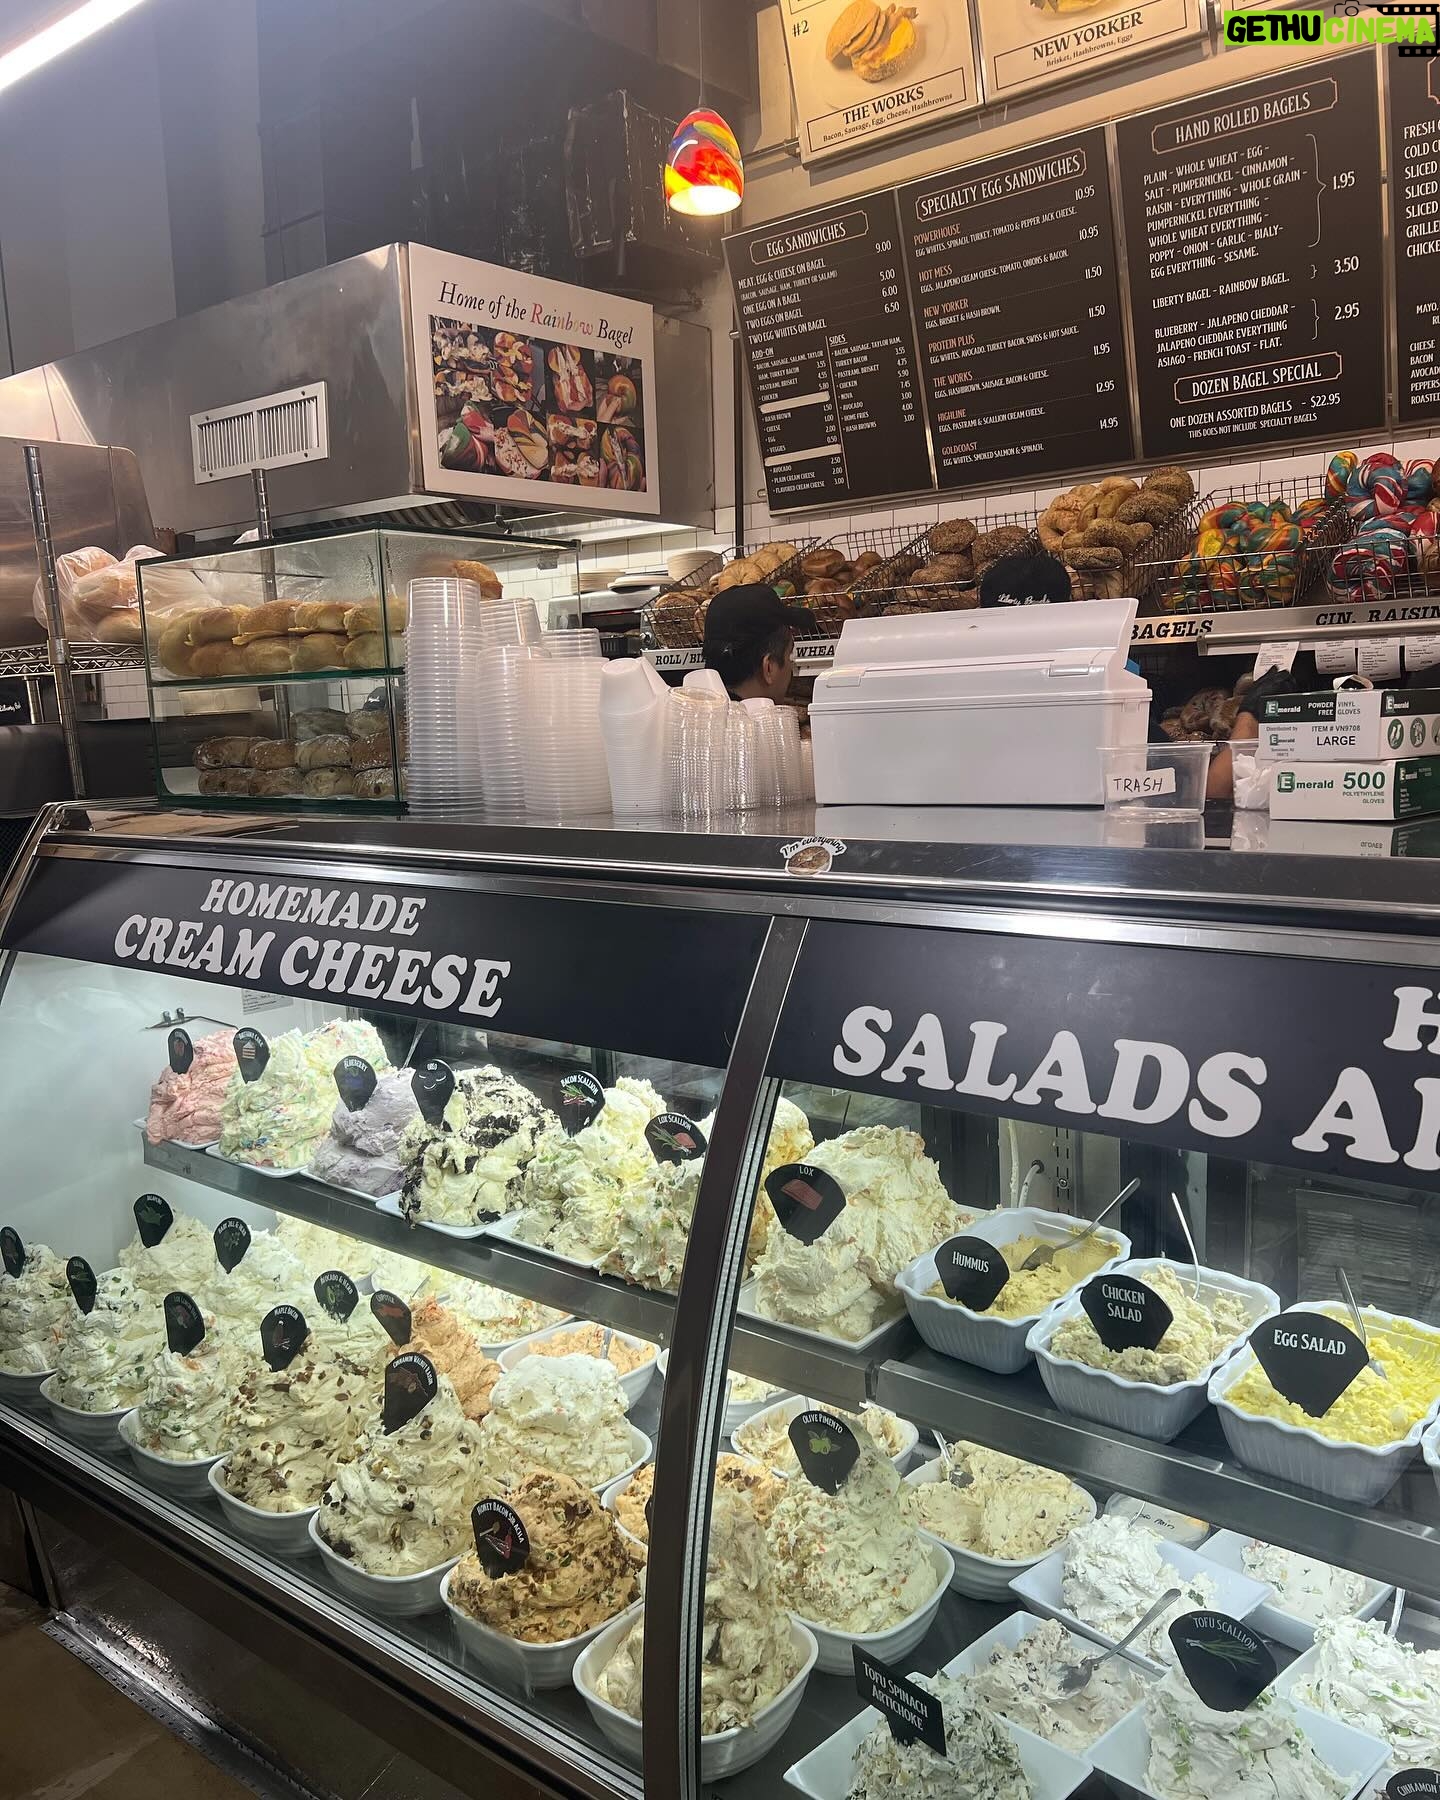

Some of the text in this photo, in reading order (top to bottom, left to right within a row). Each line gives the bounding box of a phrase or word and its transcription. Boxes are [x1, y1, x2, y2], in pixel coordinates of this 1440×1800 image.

[792, 20, 809, 38] #2
[1033, 11, 1143, 61] NEW YORKER
[842, 86, 924, 124] THE WORKS
[823, 93, 953, 142] Bacon, Sausage, Egg, Cheese, Hashbrowns
[1175, 92, 1311, 144] HAND ROLLED BAGELS
[1404, 119, 1436, 140] FRESH
[1404, 142, 1430, 159] COLD
[1143, 145, 1263, 186] PLAIN WHOLE WHEAT EGG
[1405, 160, 1438, 180] SLICED
[921, 154, 1081, 217] SPECIALTY EGG SANDWICHES
[1144, 155, 1289, 202] SALT PUMPERNICKEL CINNAMON
[1332, 171, 1356, 191] 1.95
[1075, 185, 1095, 201] 10.95
[1146, 169, 1301, 217] RAISIN EVERYTHING WHOLE GRAIN
[1405, 180, 1438, 200] SLICED
[1147, 196, 1260, 233] PUMPERNICKEL EVERYTHING
[1406, 200, 1439, 220] SLICED
[913, 222, 961, 246] POWERHOUSE
[1079, 225, 1099, 241] 10.95
[1149, 211, 1263, 248] WHOLE WHEAT EVERYTHING
[1406, 220, 1440, 238] GRILLE
[766, 222, 846, 257] EGG SANDWICHES
[875, 240, 892, 254] 9.00
[1149, 232, 1247, 264] POPPY ONION GARLIC
[1407, 239, 1440, 258] CHICKE
[879, 268, 896, 282] 5.00
[918, 265, 953, 282] HOT MESS
[1085, 265, 1103, 280] 11.50
[1150, 265, 1166, 279] EGG
[1166, 255, 1217, 276] EVERYTHING
[1334, 256, 1359, 275] 3.50
[881, 285, 898, 298] 6.00
[1152, 272, 1290, 310] LIBERTY BAGEL RAINBOW BAGEL.
[438, 281, 634, 349] Home of the Rainbow Bagel
[884, 301, 900, 314] 6.50
[923, 298, 969, 318] NEW YORKER
[1088, 304, 1106, 319] 11.50
[1334, 302, 1360, 321] 2.95
[1155, 303, 1289, 340] BLUEBERRY JALAPENO CHEDDAR
[829, 334, 846, 345] SIDES
[928, 333, 976, 353] PROTEIN PLUS
[1156, 319, 1288, 354] JALAPENO CHEDDAR EVERYTHING
[1409, 339, 1436, 352] CHEESE
[1093, 343, 1111, 356] 11.95
[1157, 336, 1283, 369] ASIAGO FRENCH TOAST FLAT.
[1410, 353, 1434, 366] BACON
[933, 371, 973, 388] THE WORKS
[1096, 380, 1115, 393] 12.95
[1192, 361, 1322, 397] DOZEN BAGEL SPECIAL
[1170, 392, 1341, 429] ONE DOZEN ASSORTED BAGELS $22.95
[1100, 416, 1119, 430] 14.95
[1315, 612, 1357, 626] CIN.
[796, 645, 835, 658] WHEA
[1266, 701, 1301, 717] Emerald
[1317, 735, 1356, 746] LARGE
[1113, 777, 1164, 793] TRASH
[1277, 771, 1334, 793] Emerald
[1343, 771, 1385, 790] 500
[200, 878, 426, 936] HOMEMADE
[114, 914, 512, 1018] CREAM CHEESE
[560, 1075, 578, 1088] BACON
[833, 1005, 1268, 1138] SALADS
[799, 1167, 815, 1177] LOX
[952, 1251, 990, 1274] HUMMUS
[1102, 1283, 1146, 1306] CHICKEN
[1107, 1302, 1142, 1323] SALAD
[1273, 1329, 1347, 1356] EGG SALAD
[802, 1413, 843, 1434] OLIVE PIMENTO
[1192, 1616, 1258, 1654] TOFU SCALLION
[862, 1661, 928, 1718] TOFU SPINACH
[872, 1685, 923, 1731] ARTICHOKE
[1396, 1783, 1437, 1797] CINNAMON
